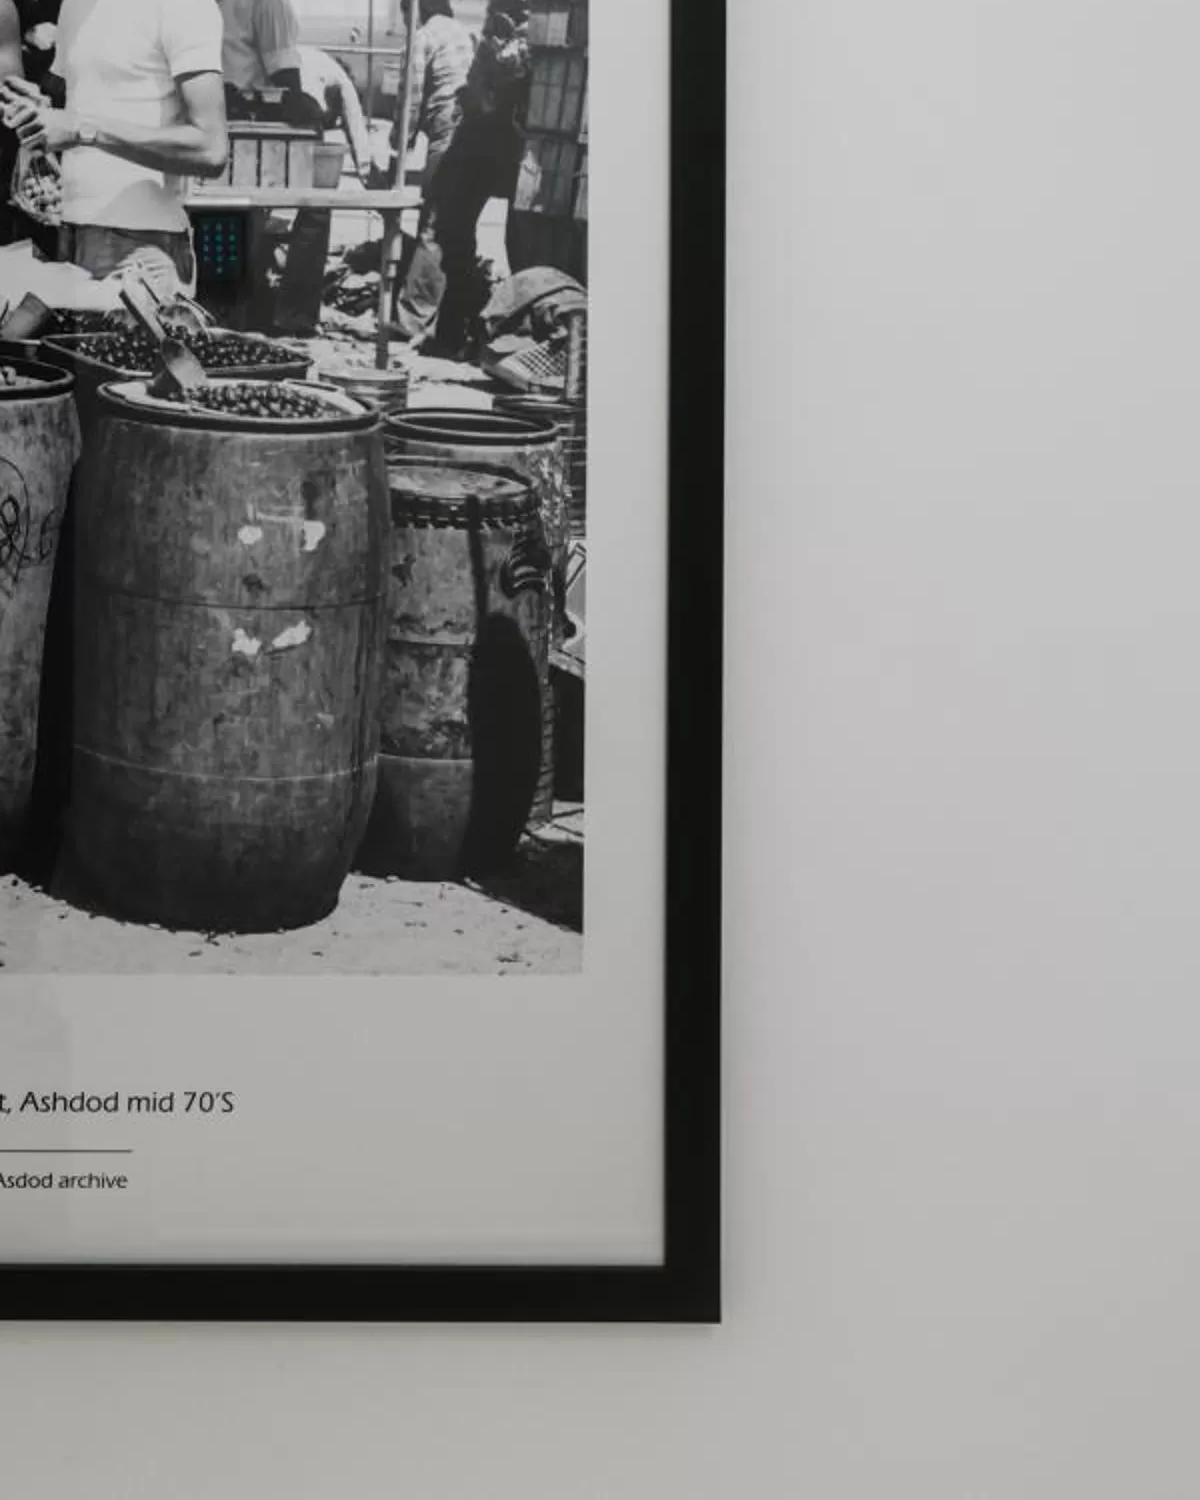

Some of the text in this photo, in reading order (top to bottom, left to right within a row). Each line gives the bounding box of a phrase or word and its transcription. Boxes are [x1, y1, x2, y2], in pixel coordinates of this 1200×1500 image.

[19, 1091, 119, 1114] Ashdod
[127, 1091, 175, 1114] mid
[183, 1091, 234, 1114] 70'S
[58, 1172, 129, 1189] archive
